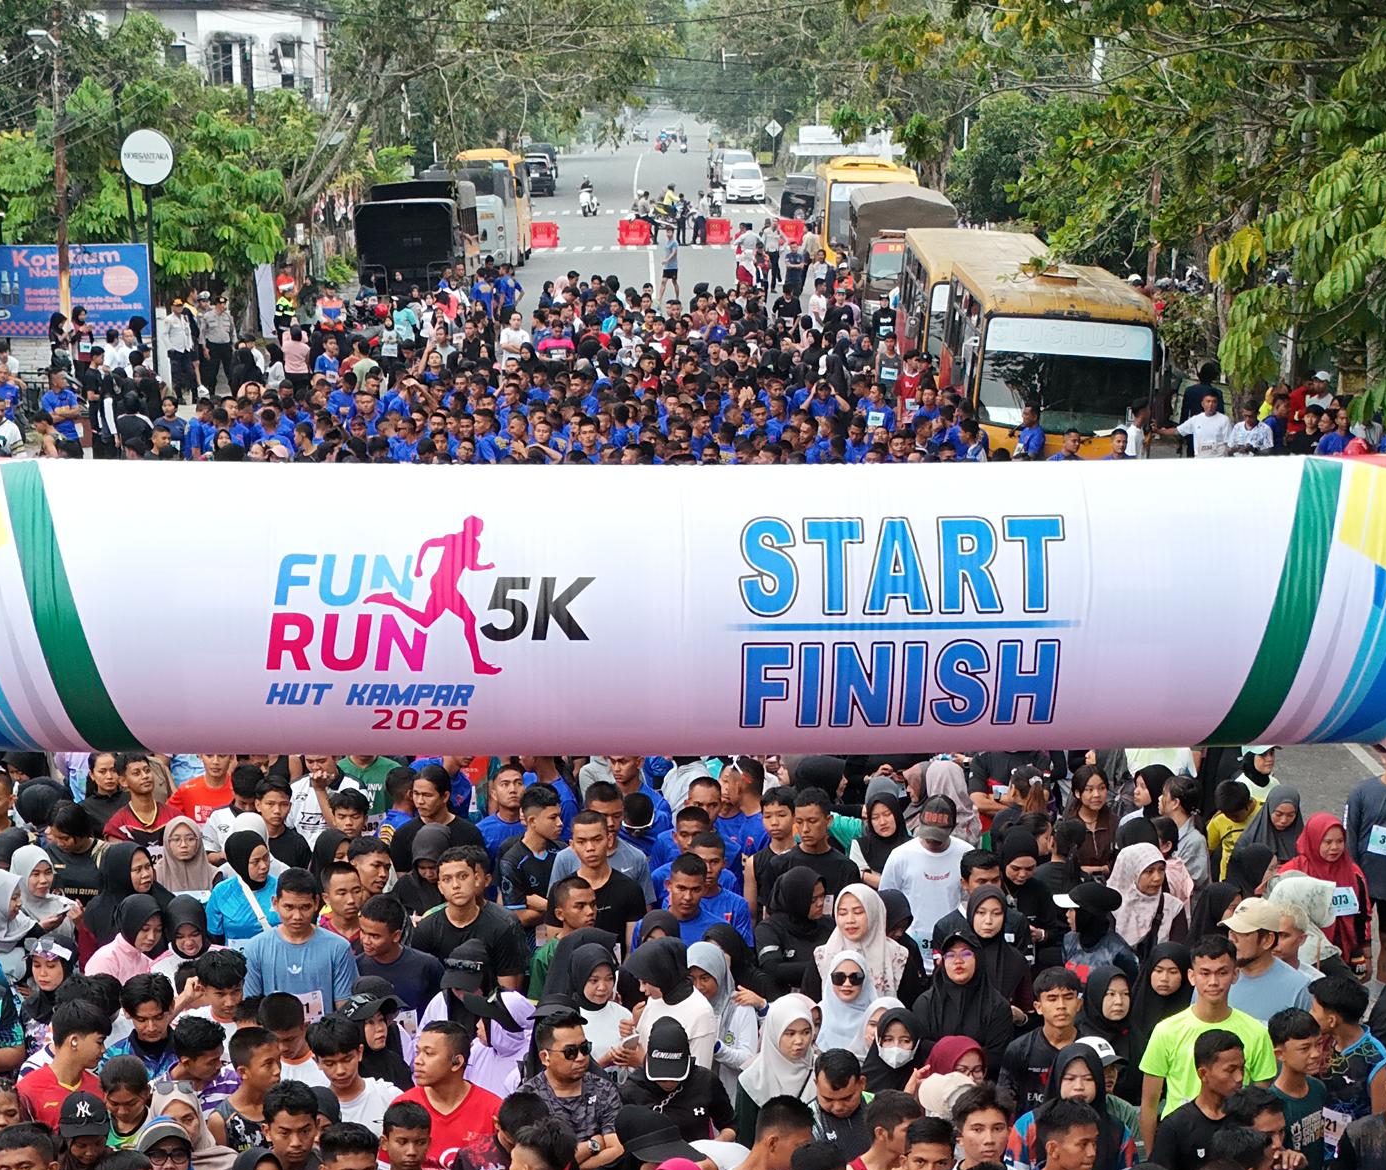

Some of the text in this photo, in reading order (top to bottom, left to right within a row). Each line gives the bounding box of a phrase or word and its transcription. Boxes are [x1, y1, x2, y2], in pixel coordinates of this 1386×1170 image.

[274, 554, 415, 606] FUN
[737, 514, 1065, 618] START
[480, 577, 597, 641] 5K
[265, 613, 431, 672] RUN
[265, 683, 476, 707] HUT KAMPAR
[738, 638, 1062, 730] FINISH
[371, 708, 469, 732] 2026
